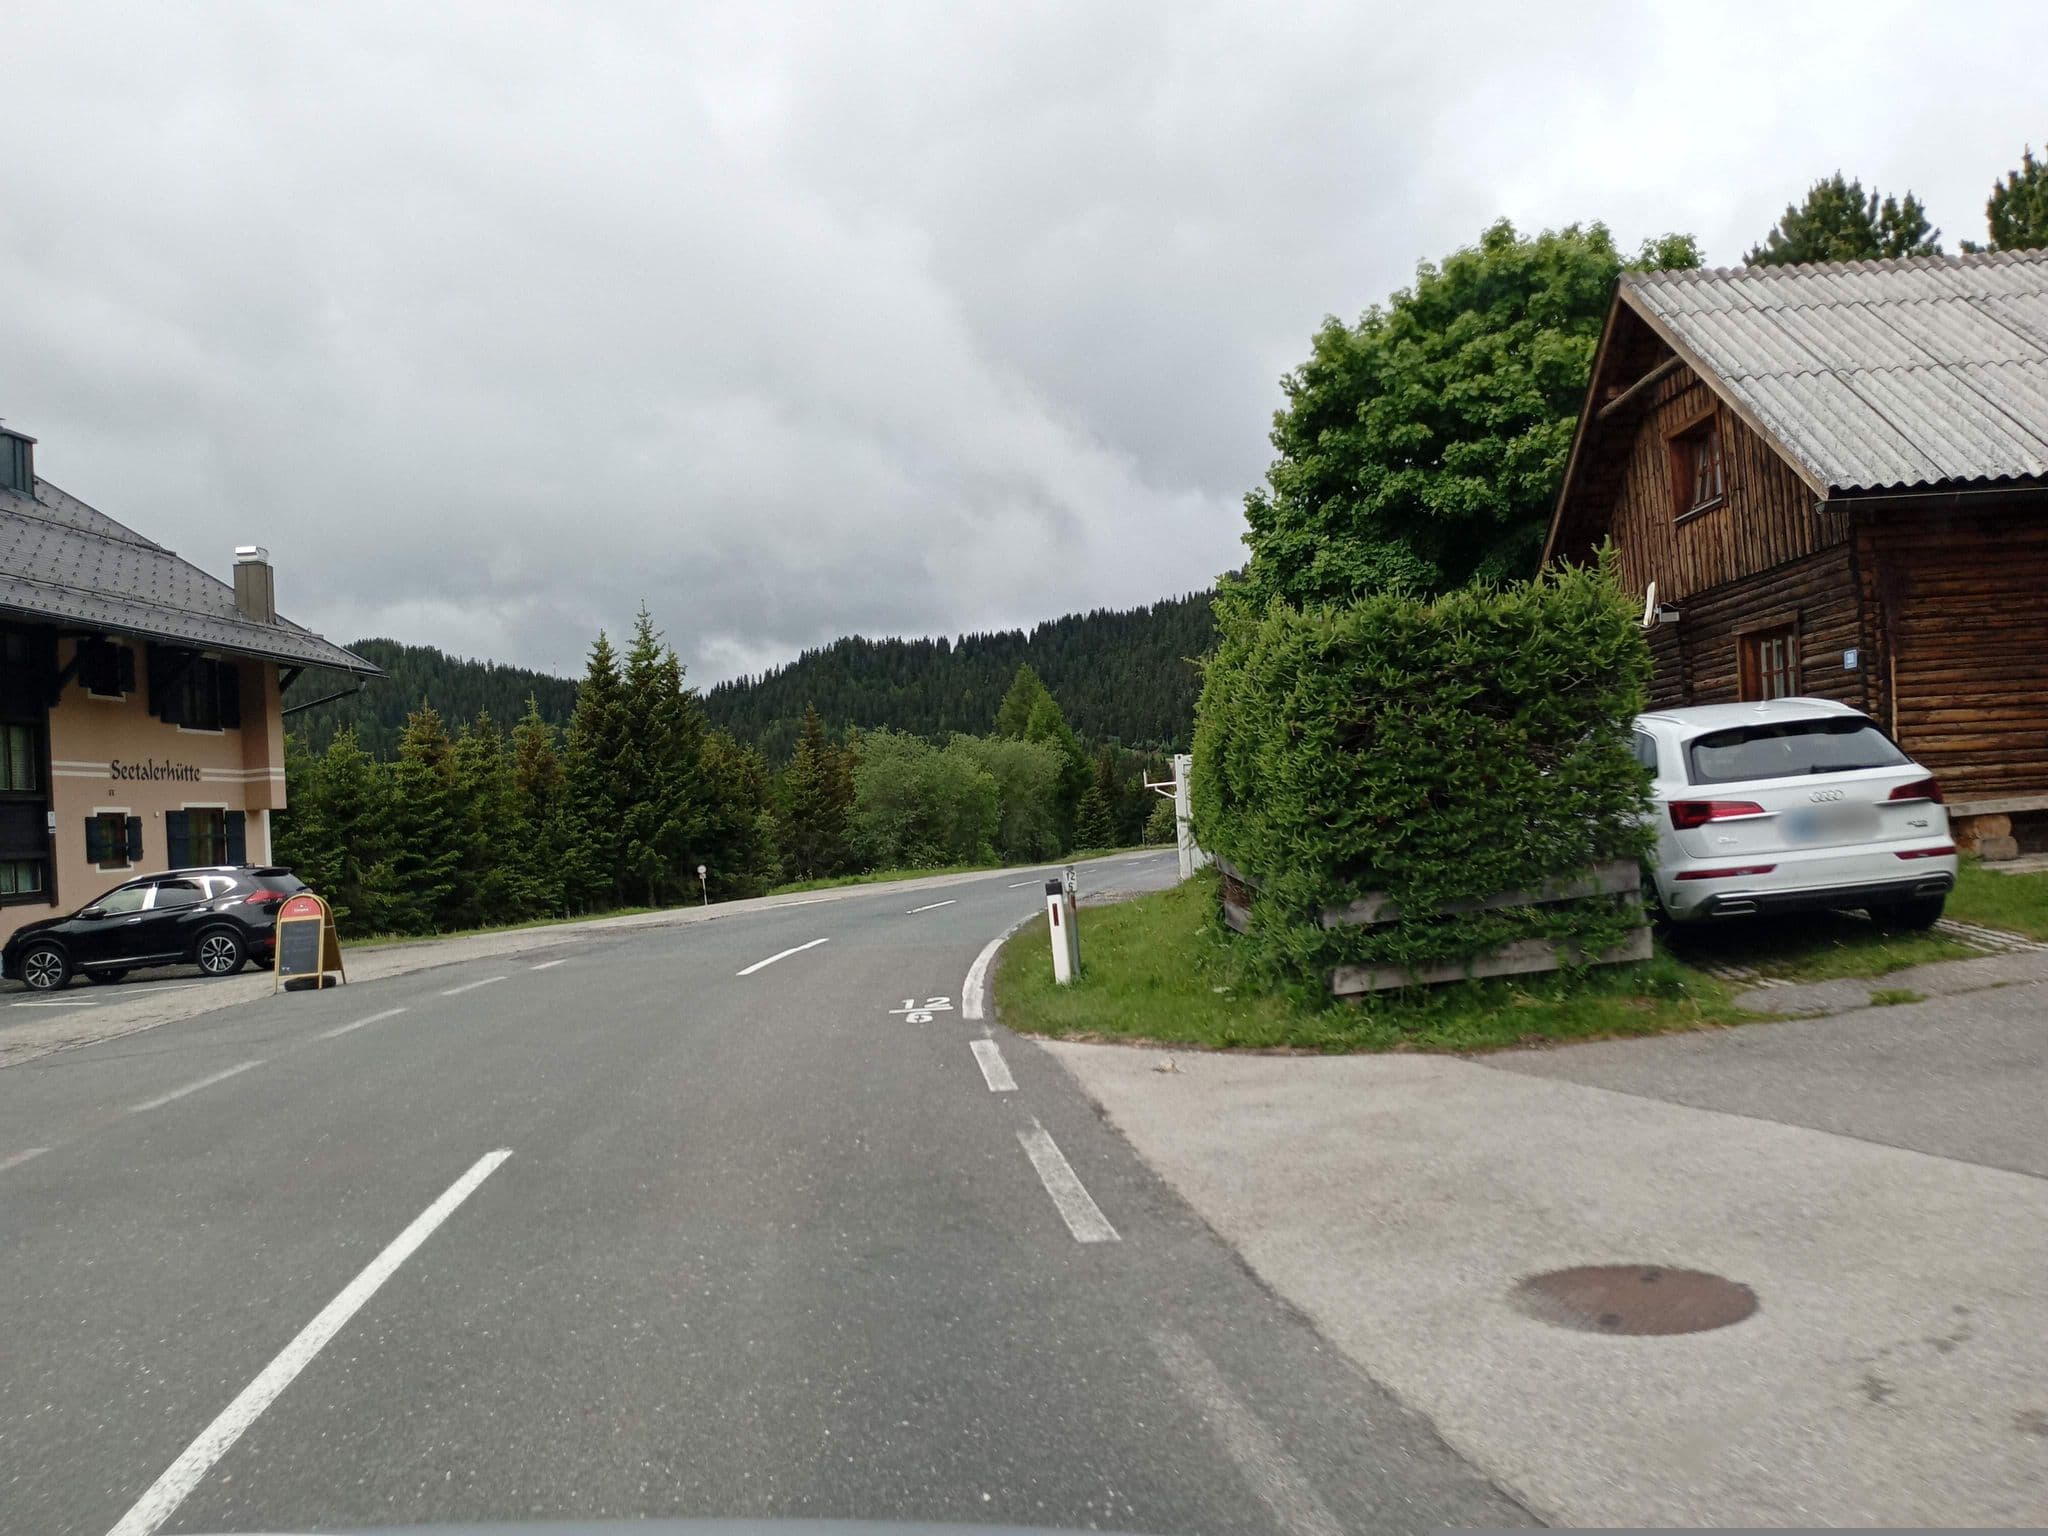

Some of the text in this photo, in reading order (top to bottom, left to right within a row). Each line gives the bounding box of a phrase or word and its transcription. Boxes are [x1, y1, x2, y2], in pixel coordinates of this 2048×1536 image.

[111, 758, 200, 781] Seetalerhütte
[1066, 871, 1076, 881] 12
[901, 997, 951, 1010] 12
[906, 1011, 933, 1024] 6
